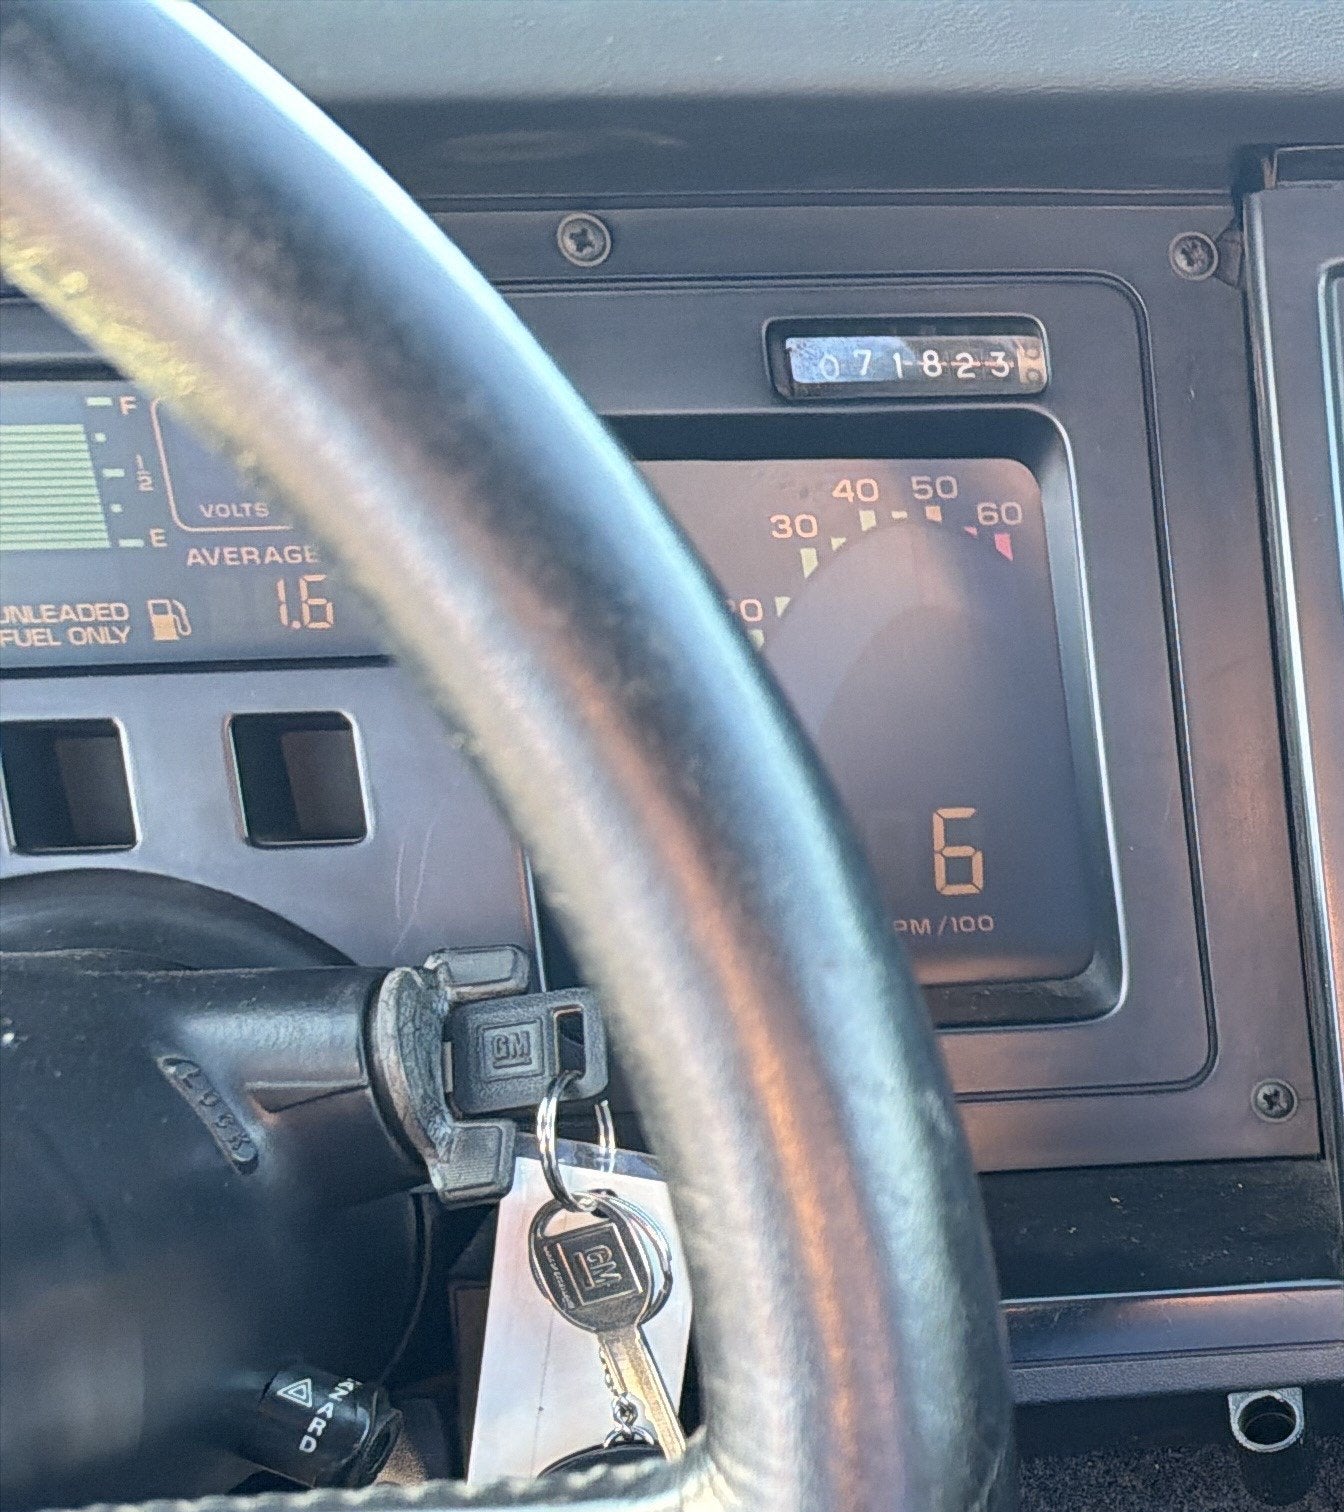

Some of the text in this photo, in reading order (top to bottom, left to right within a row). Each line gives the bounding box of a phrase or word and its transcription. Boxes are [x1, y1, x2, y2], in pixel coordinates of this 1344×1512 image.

[119, 395, 137, 416] F
[831, 478, 879, 503] 40
[910, 475, 958, 500] 50
[198, 502, 270, 519] VOLTS
[976, 501, 1023, 526] 60
[149, 528, 168, 548] E
[769, 513, 818, 539] 30
[0, 625, 131, 648] FUEL ONLY
[932, 806, 984, 895] 6
[492, 1031, 530, 1060] GM
[585, 1244, 622, 1286] GM
